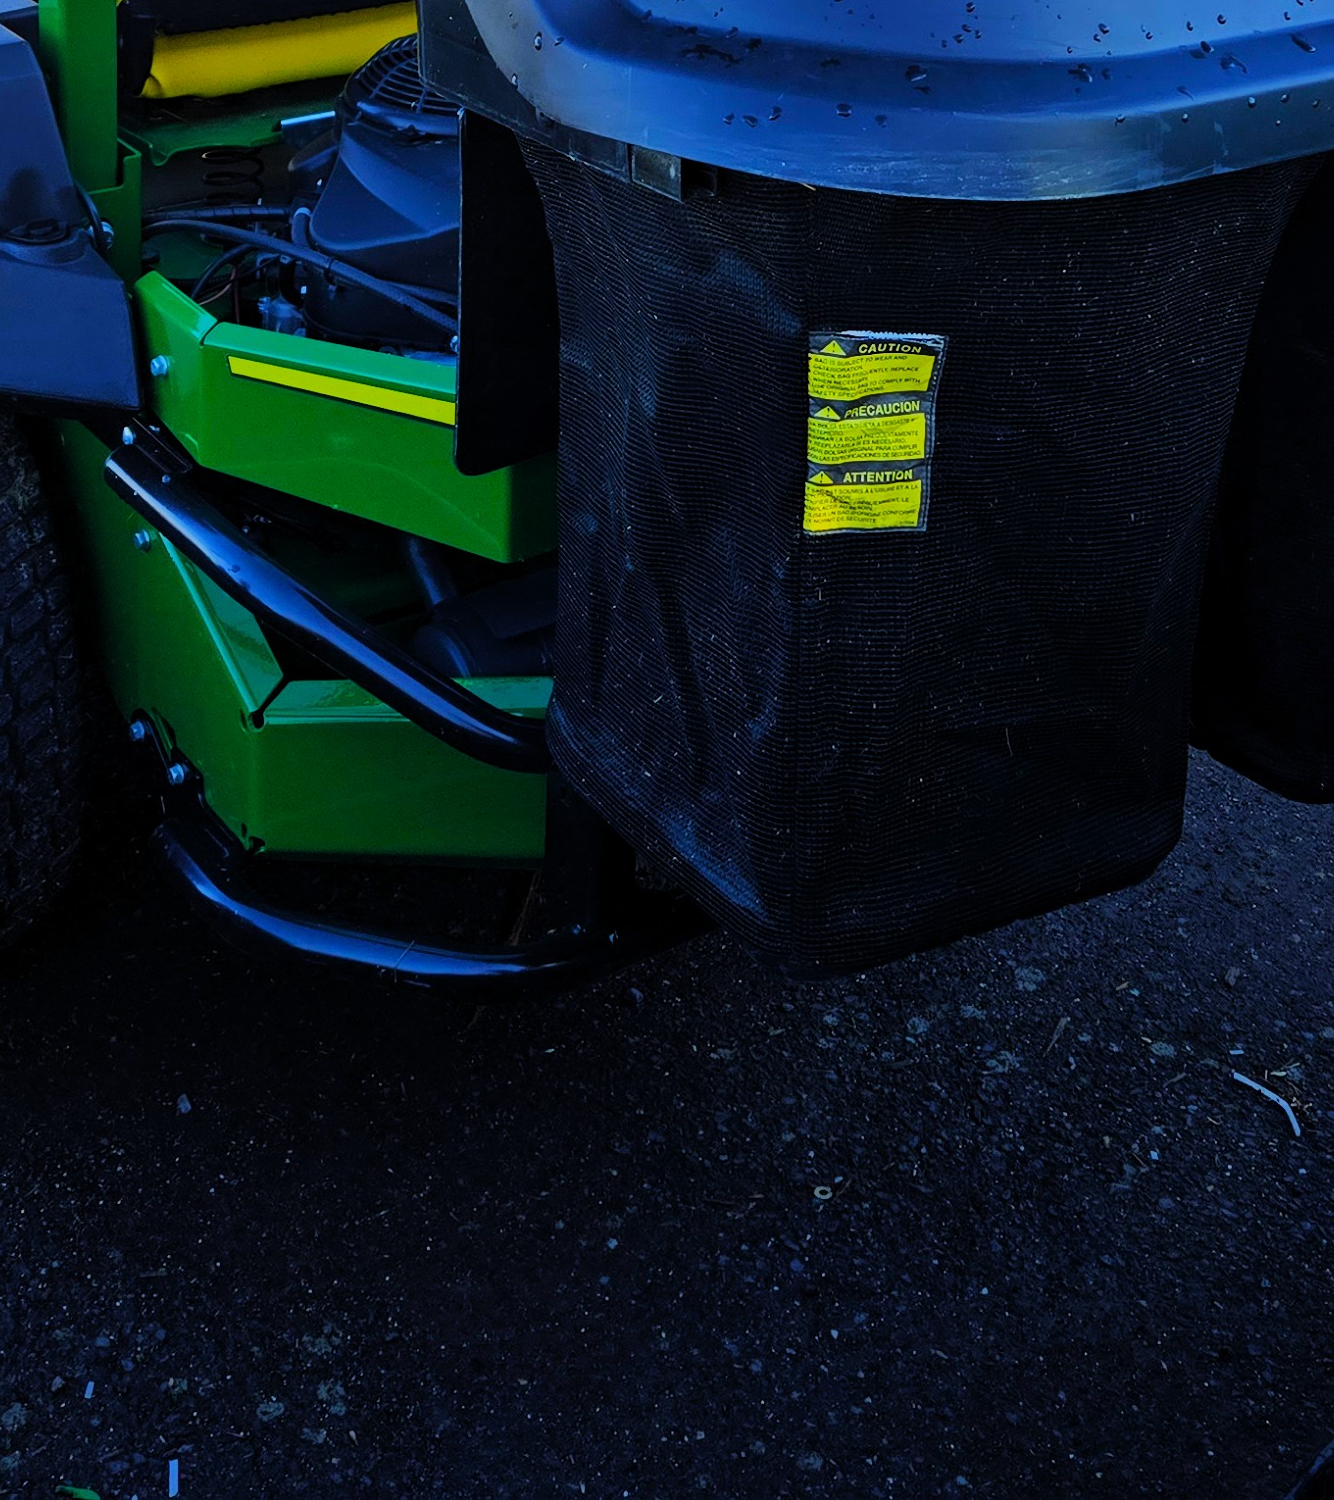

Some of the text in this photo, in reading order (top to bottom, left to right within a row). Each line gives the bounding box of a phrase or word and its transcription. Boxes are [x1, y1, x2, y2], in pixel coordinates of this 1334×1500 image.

[858, 343, 922, 354] CAUTION
[845, 401, 920, 418] PRECAUCION
[843, 470, 913, 483] ATTENTION
